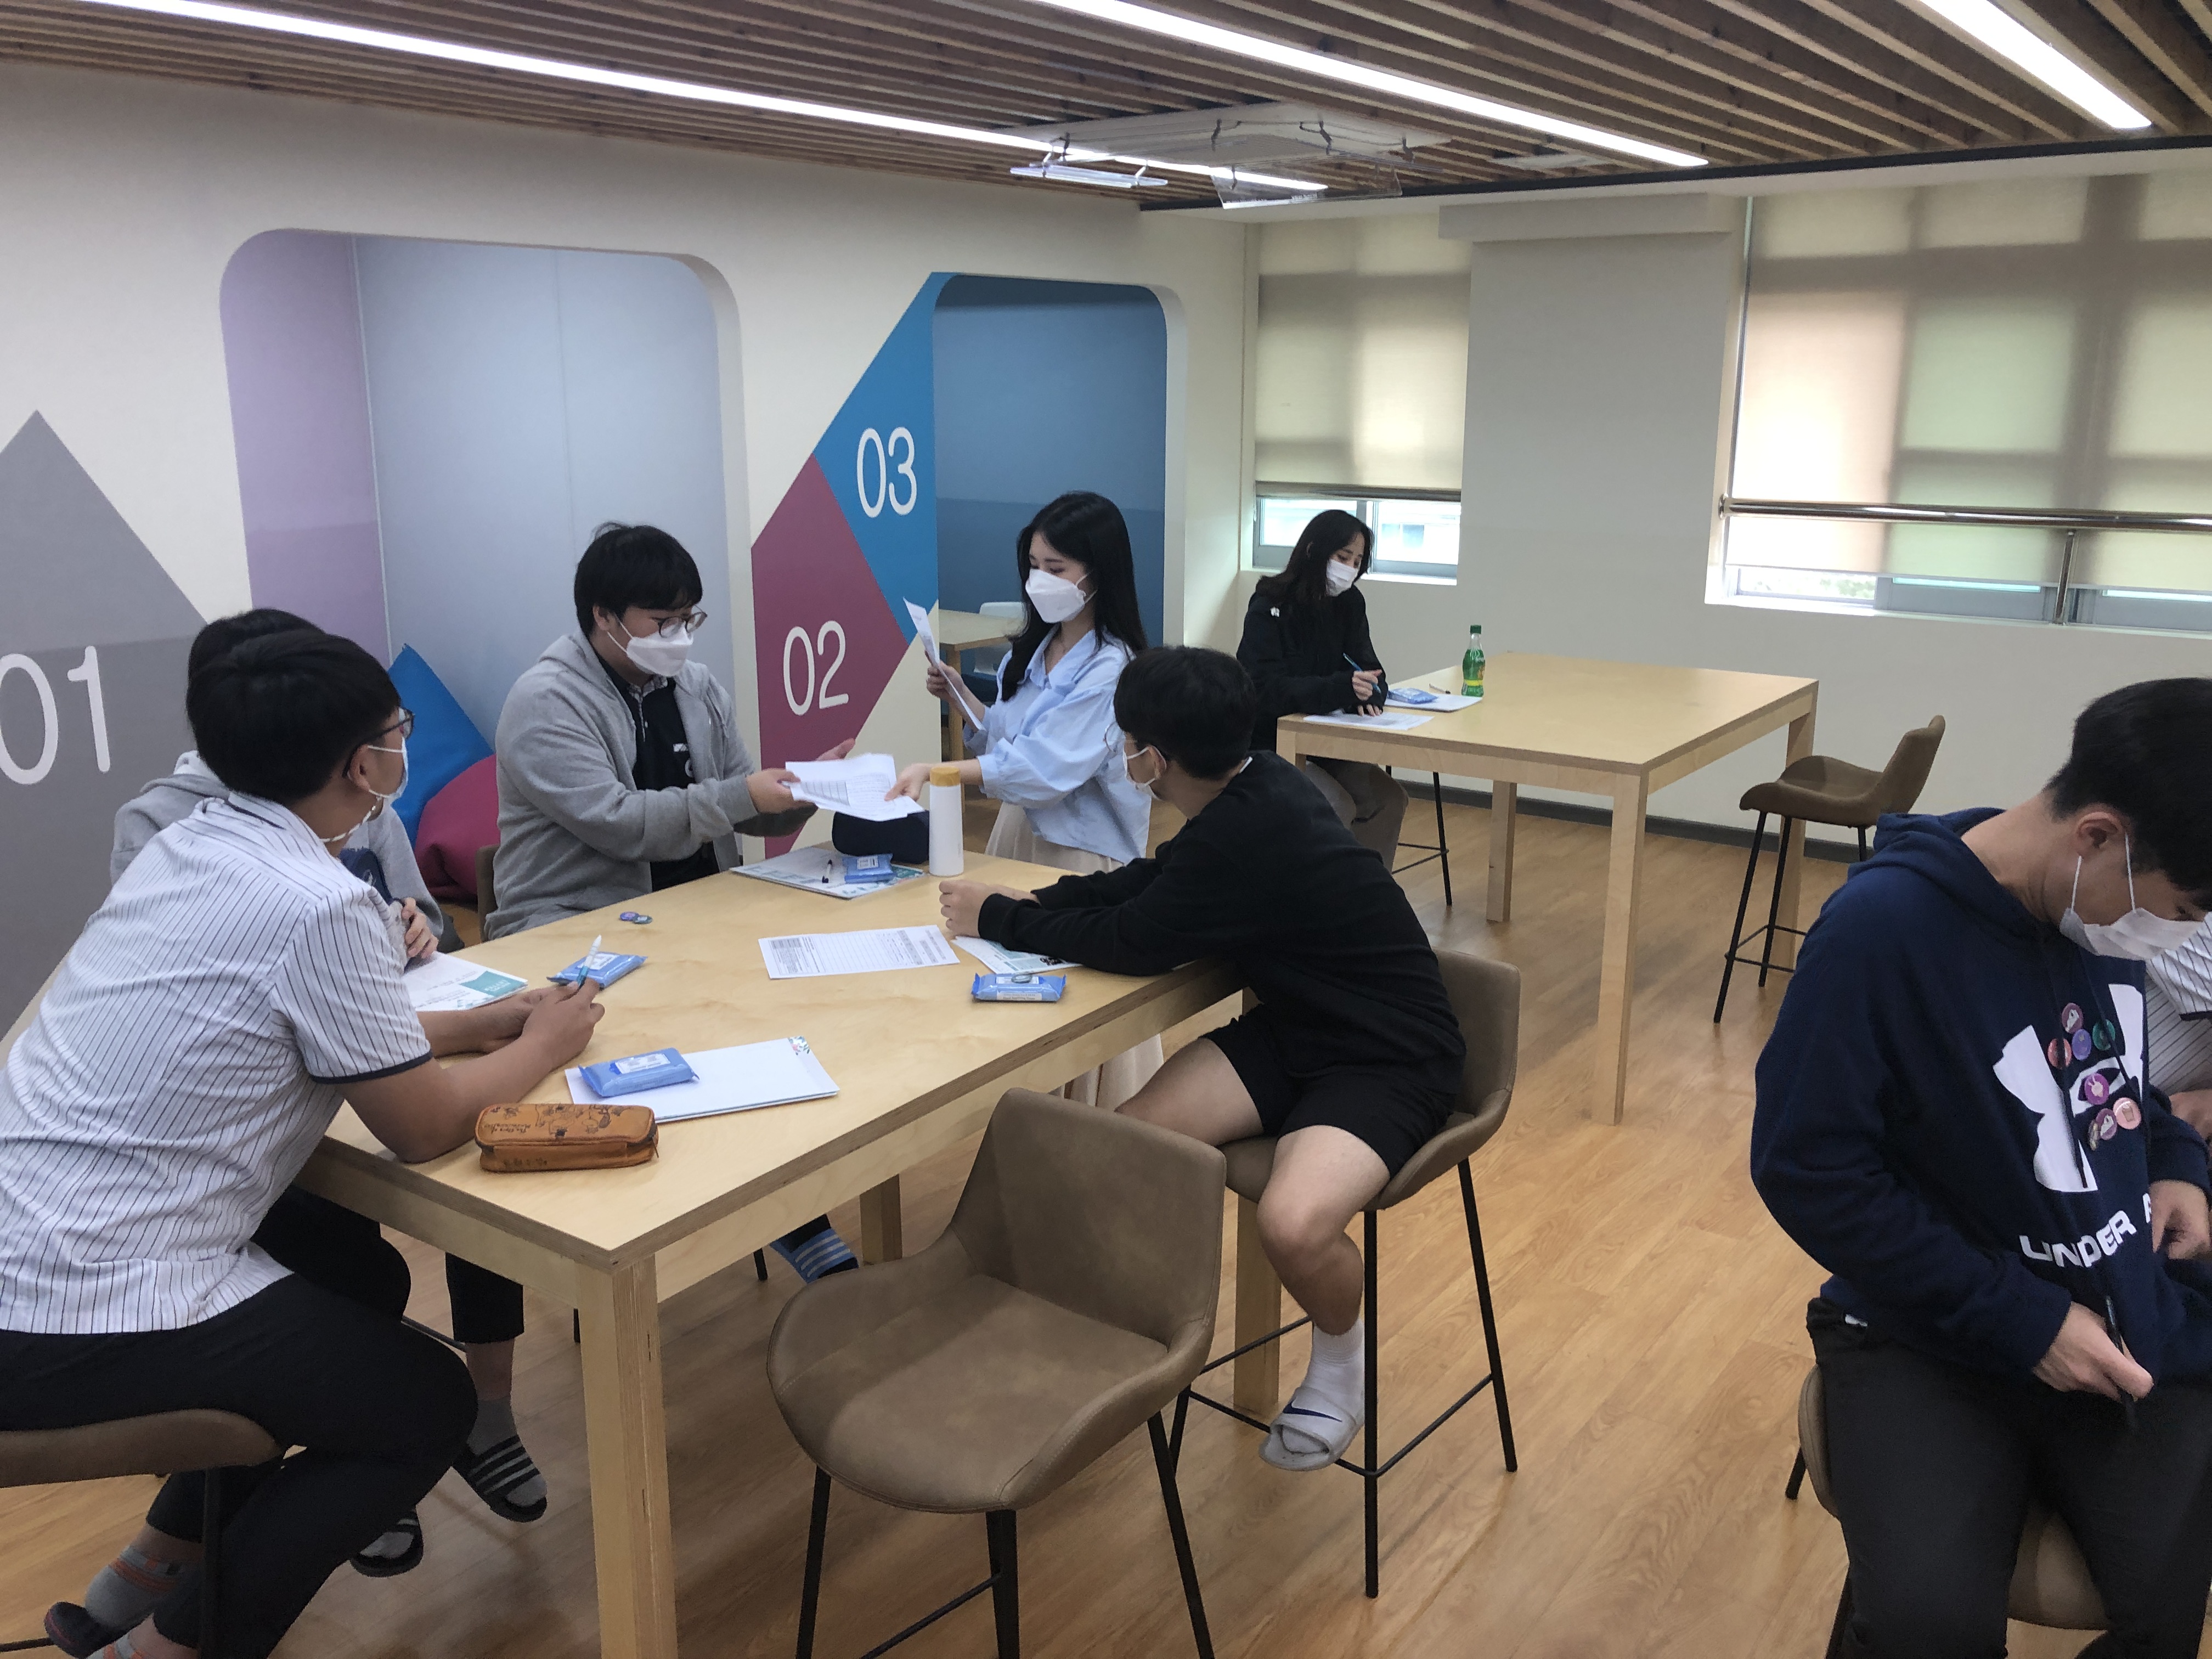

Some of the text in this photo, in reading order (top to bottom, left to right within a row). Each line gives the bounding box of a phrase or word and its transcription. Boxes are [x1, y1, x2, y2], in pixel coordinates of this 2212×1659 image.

[857, 426, 917, 518] 03
[783, 620, 849, 715] 02
[0, 646, 110, 785] 01
[2019, 1210, 2137, 1268] UNDER
